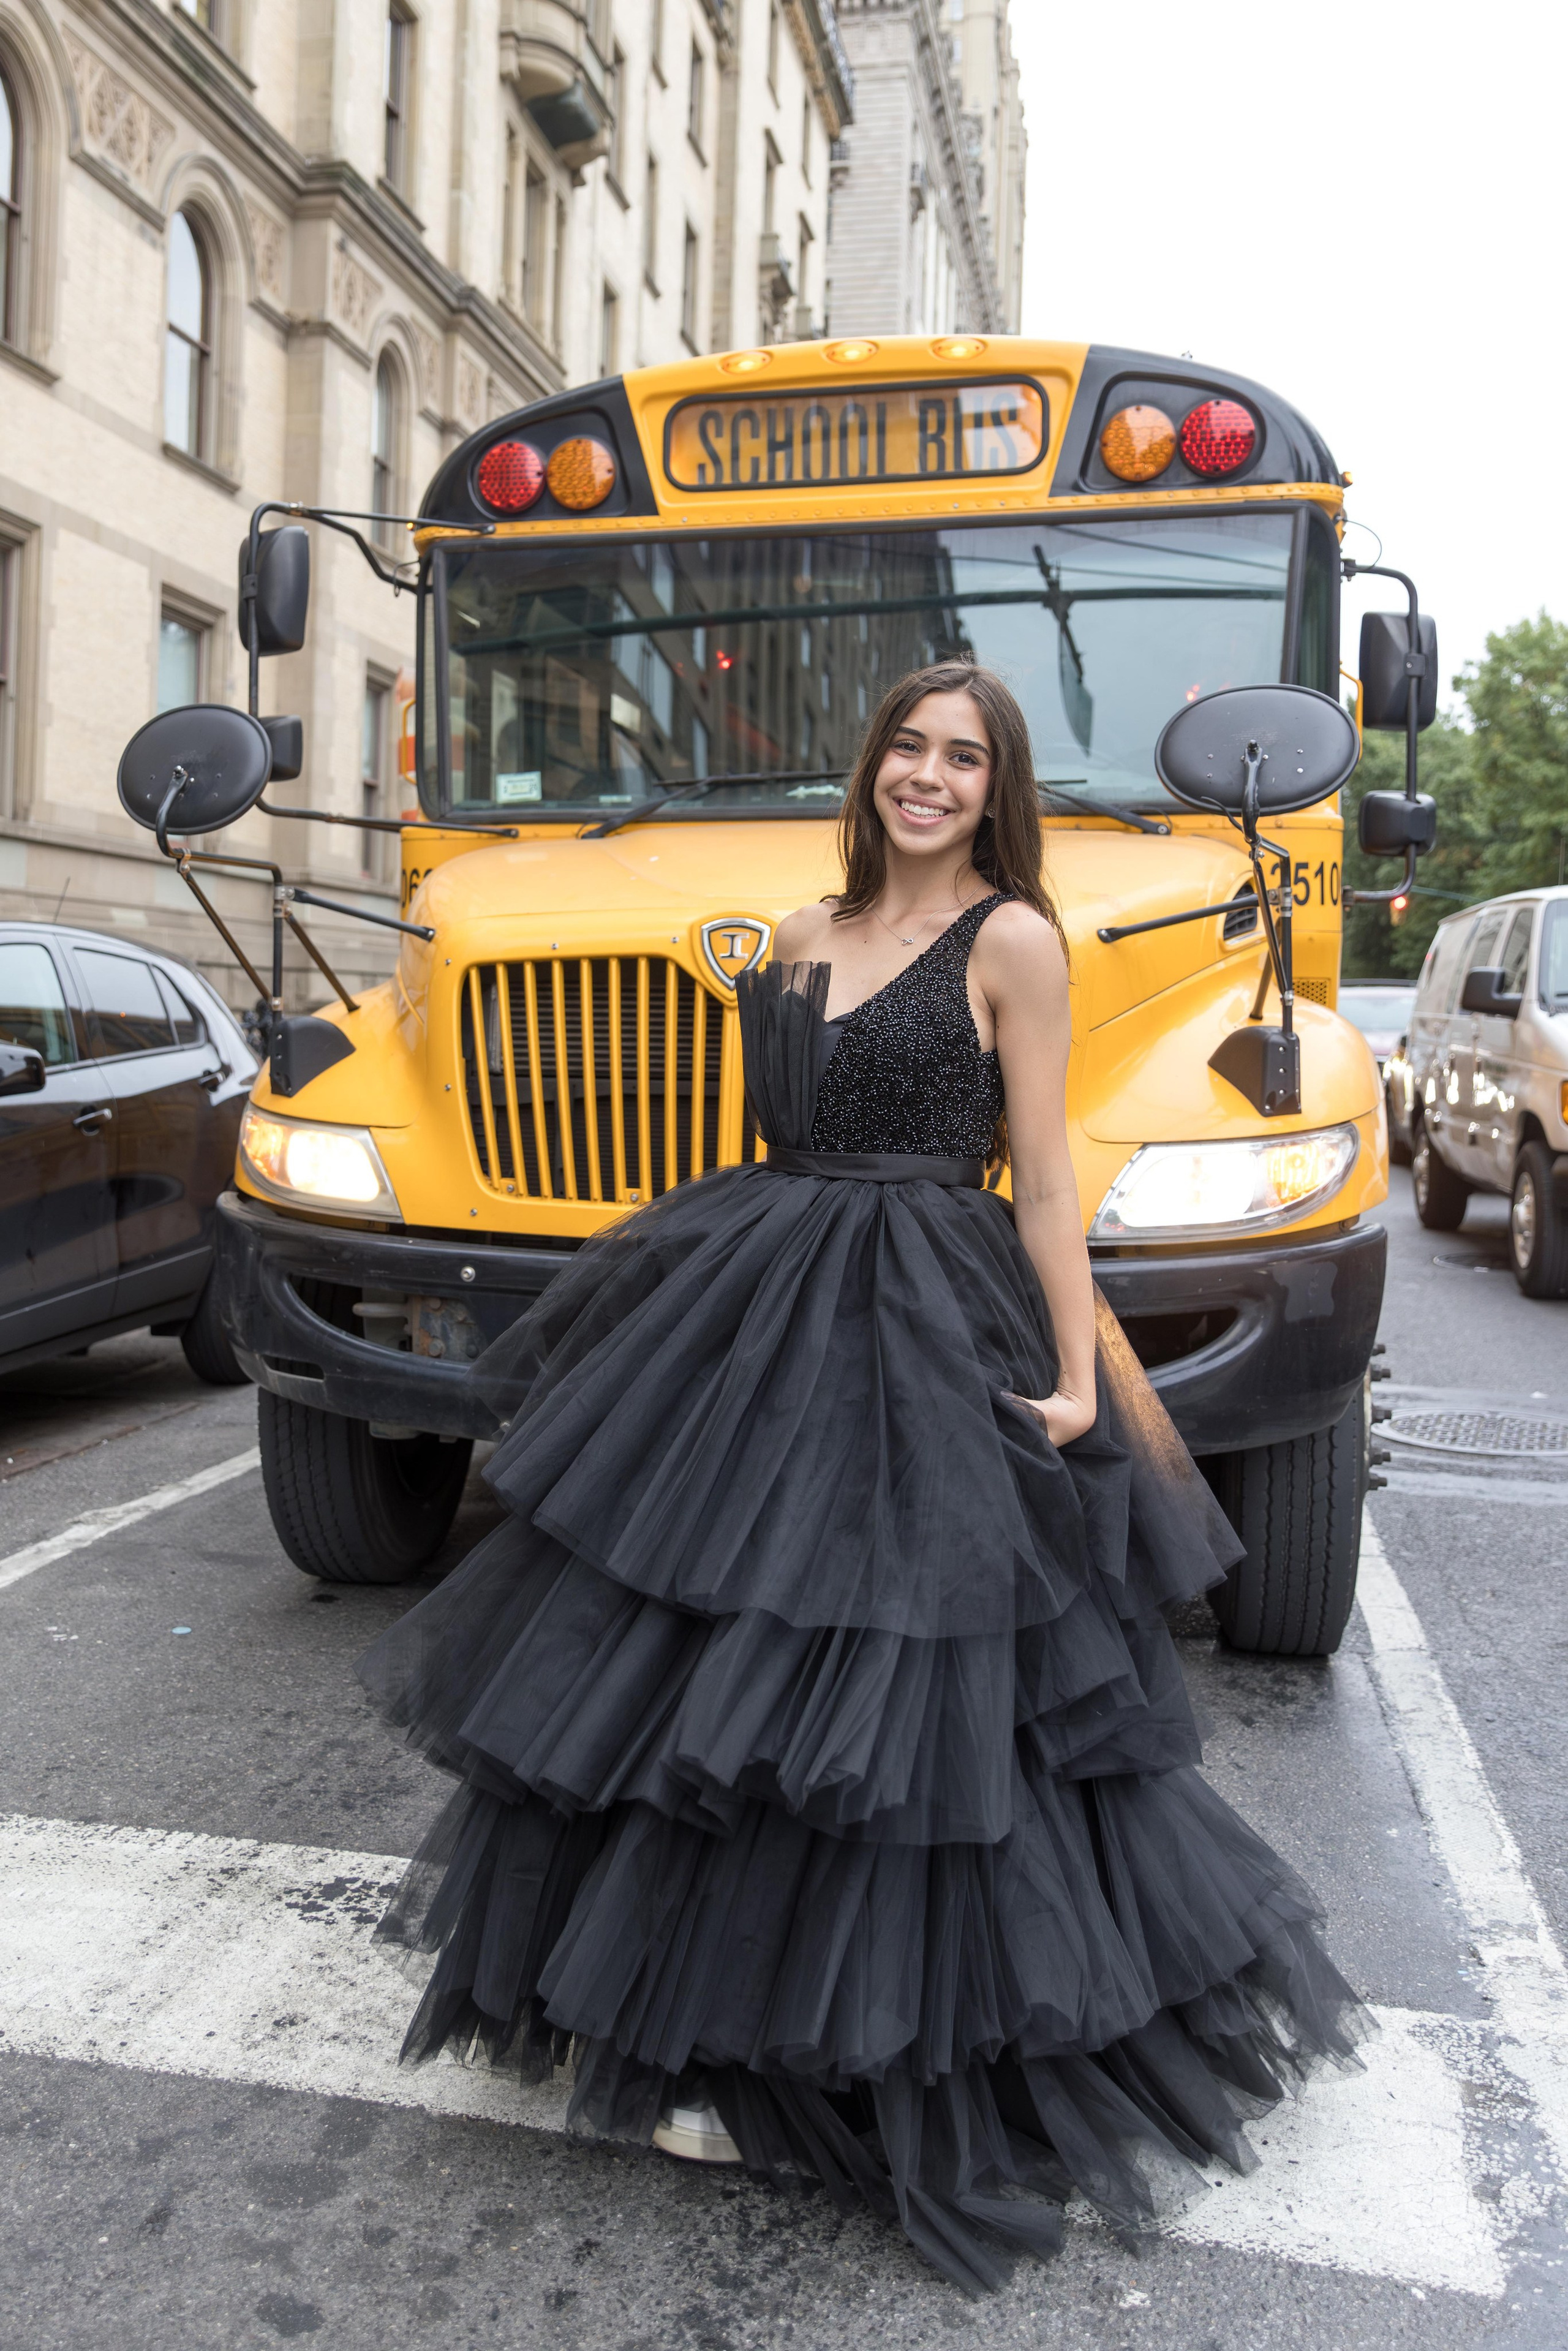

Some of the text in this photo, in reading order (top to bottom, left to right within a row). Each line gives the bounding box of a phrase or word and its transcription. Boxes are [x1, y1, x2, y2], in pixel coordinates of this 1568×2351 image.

[697, 392, 1019, 486] SCHOOL BUS
[1270, 862, 1339, 906] 510
